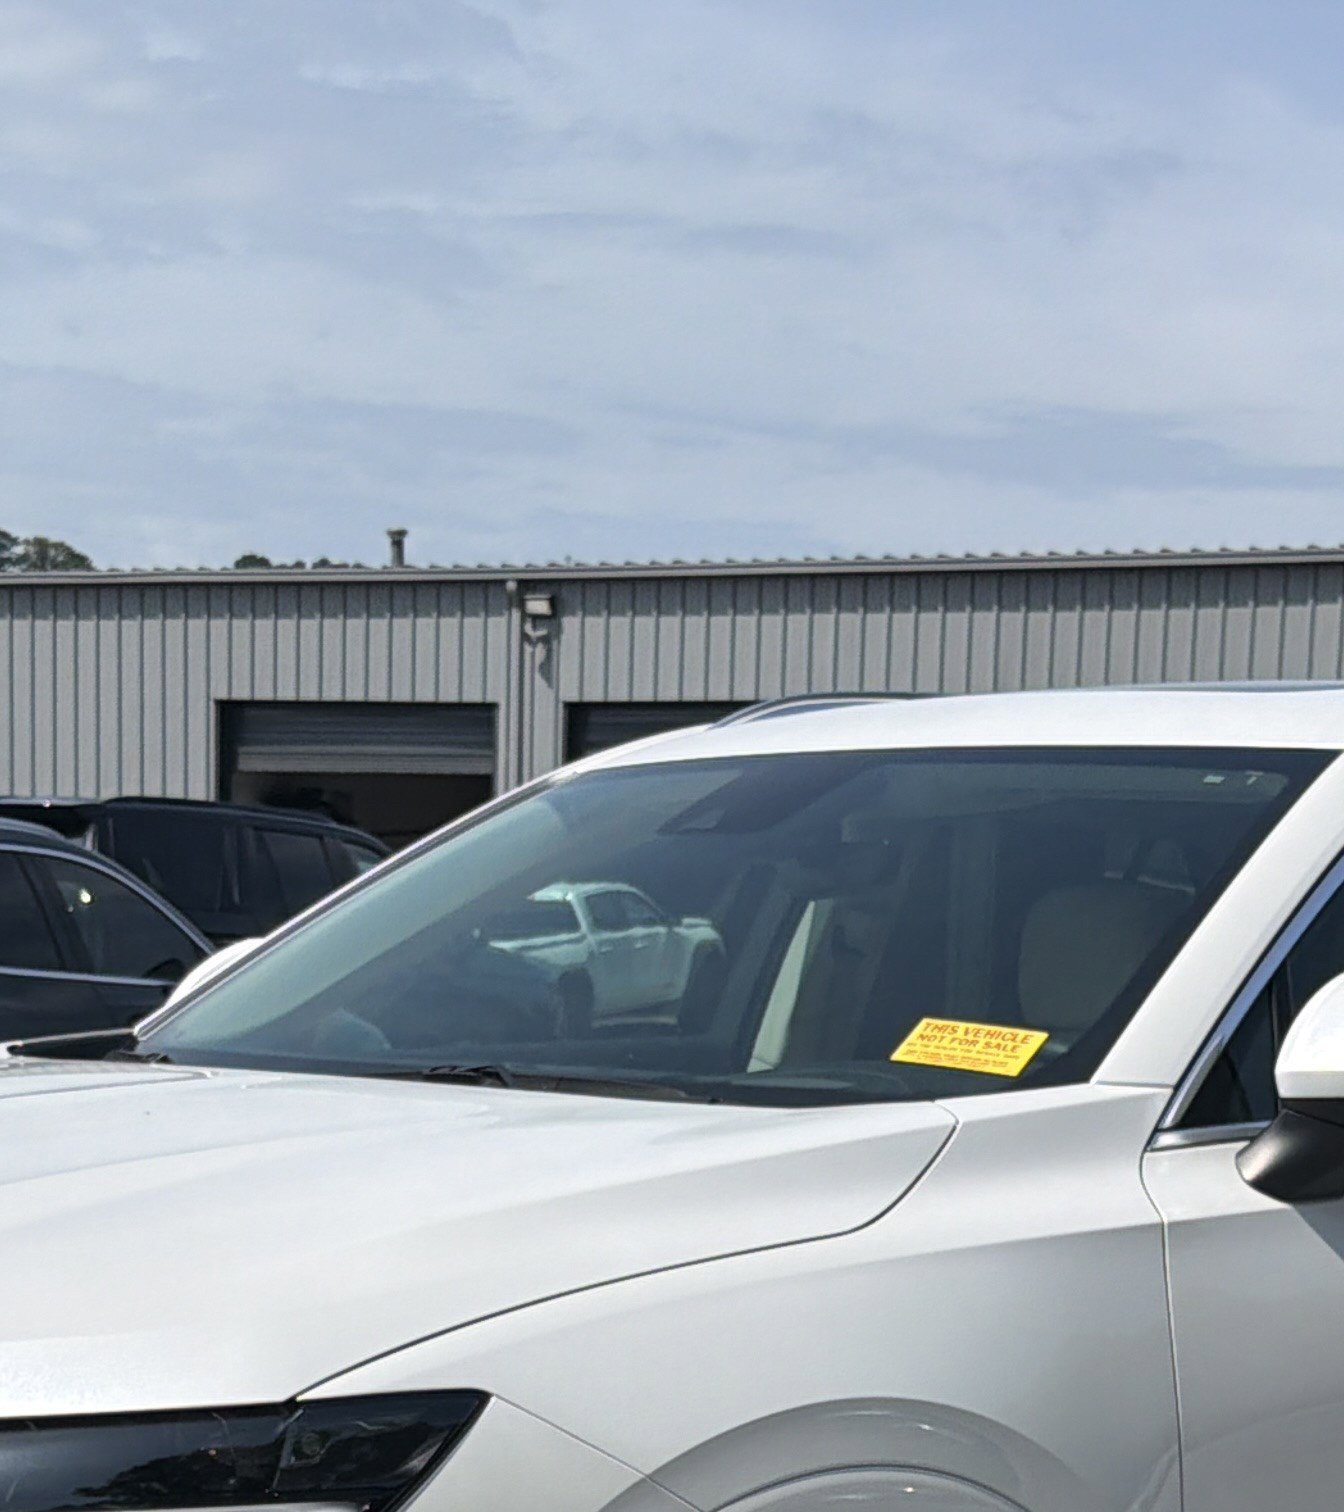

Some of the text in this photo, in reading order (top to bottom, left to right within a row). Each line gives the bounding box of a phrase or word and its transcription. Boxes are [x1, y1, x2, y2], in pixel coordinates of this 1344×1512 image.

[916, 1034, 945, 1044] NOT
[950, 1037, 980, 1048] FOR
[982, 1041, 1022, 1053] SALE
[922, 1022, 1034, 1045] THIS VEHICLE
